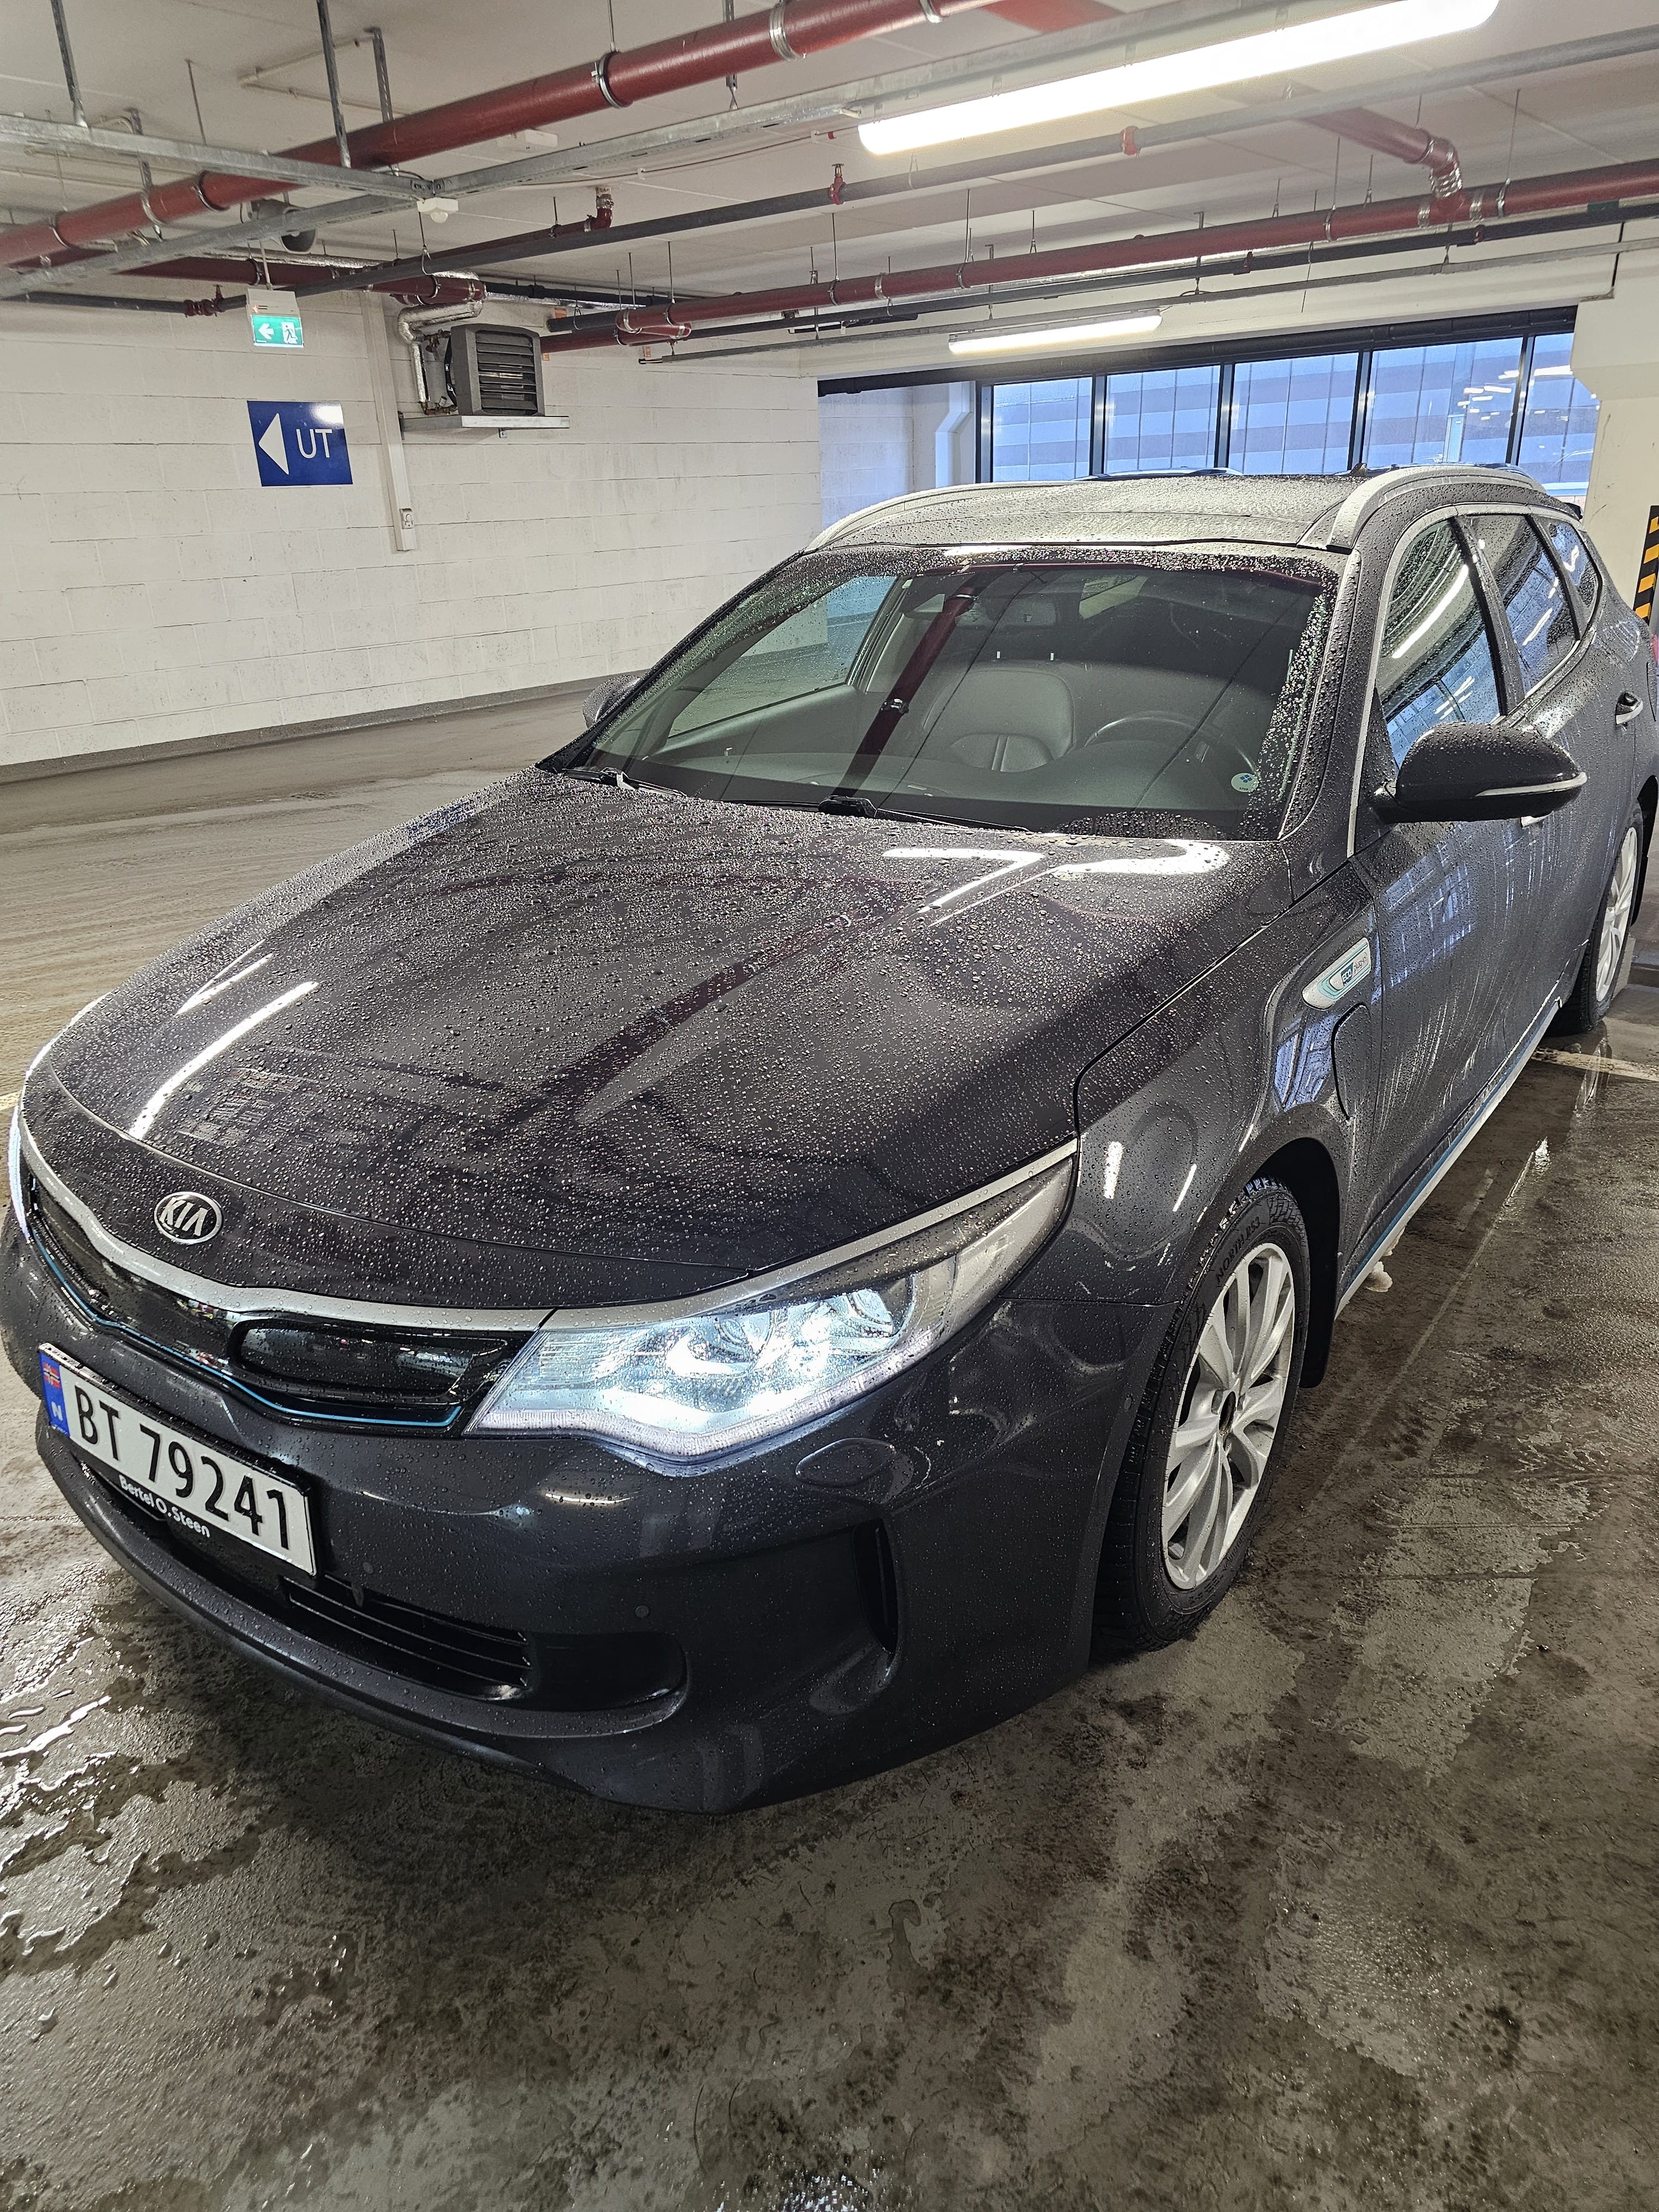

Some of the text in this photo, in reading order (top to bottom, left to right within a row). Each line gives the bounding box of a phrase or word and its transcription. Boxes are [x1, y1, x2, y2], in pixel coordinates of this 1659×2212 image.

[296, 429, 333, 459] UT
[1342, 968, 1352, 983] ECO
[159, 1196, 208, 1237] KIA
[51, 1400, 64, 1422] N
[74, 1385, 290, 1551] BT 79241
[118, 1474, 155, 1508] Bertel
[171, 1506, 211, 1538] Steen
